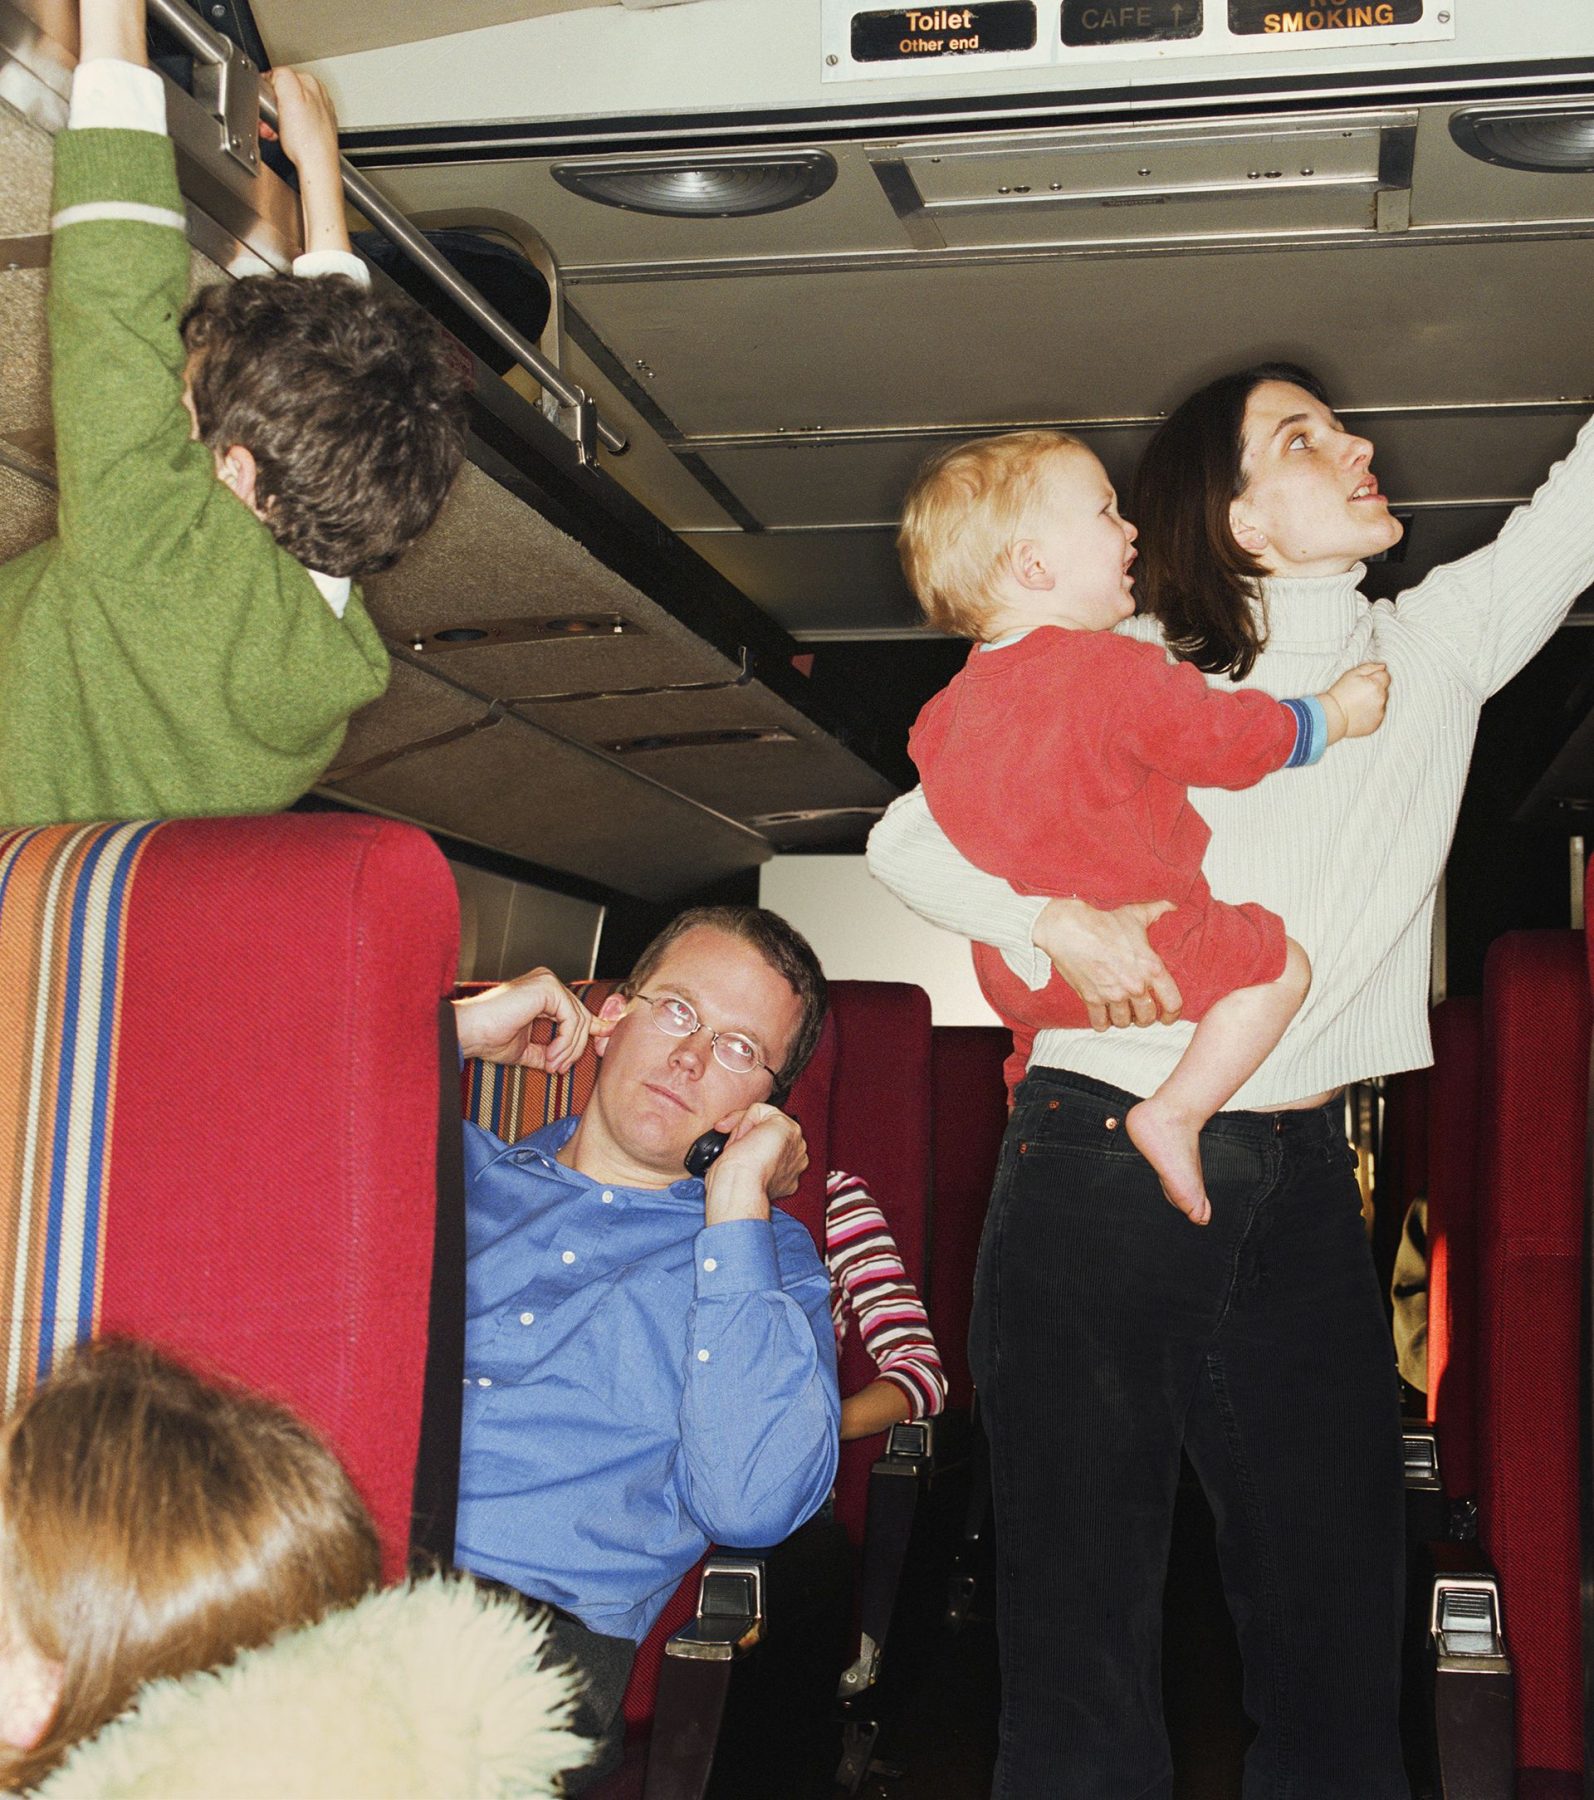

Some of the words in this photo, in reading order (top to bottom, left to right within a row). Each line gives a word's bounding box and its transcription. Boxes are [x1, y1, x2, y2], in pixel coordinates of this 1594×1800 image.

[906, 9, 972, 32] Toilet
[1081, 7, 1152, 30] CAFE
[1263, 4, 1394, 33] SMOKING
[899, 38, 944, 53] Other
[949, 35, 979, 50] end
